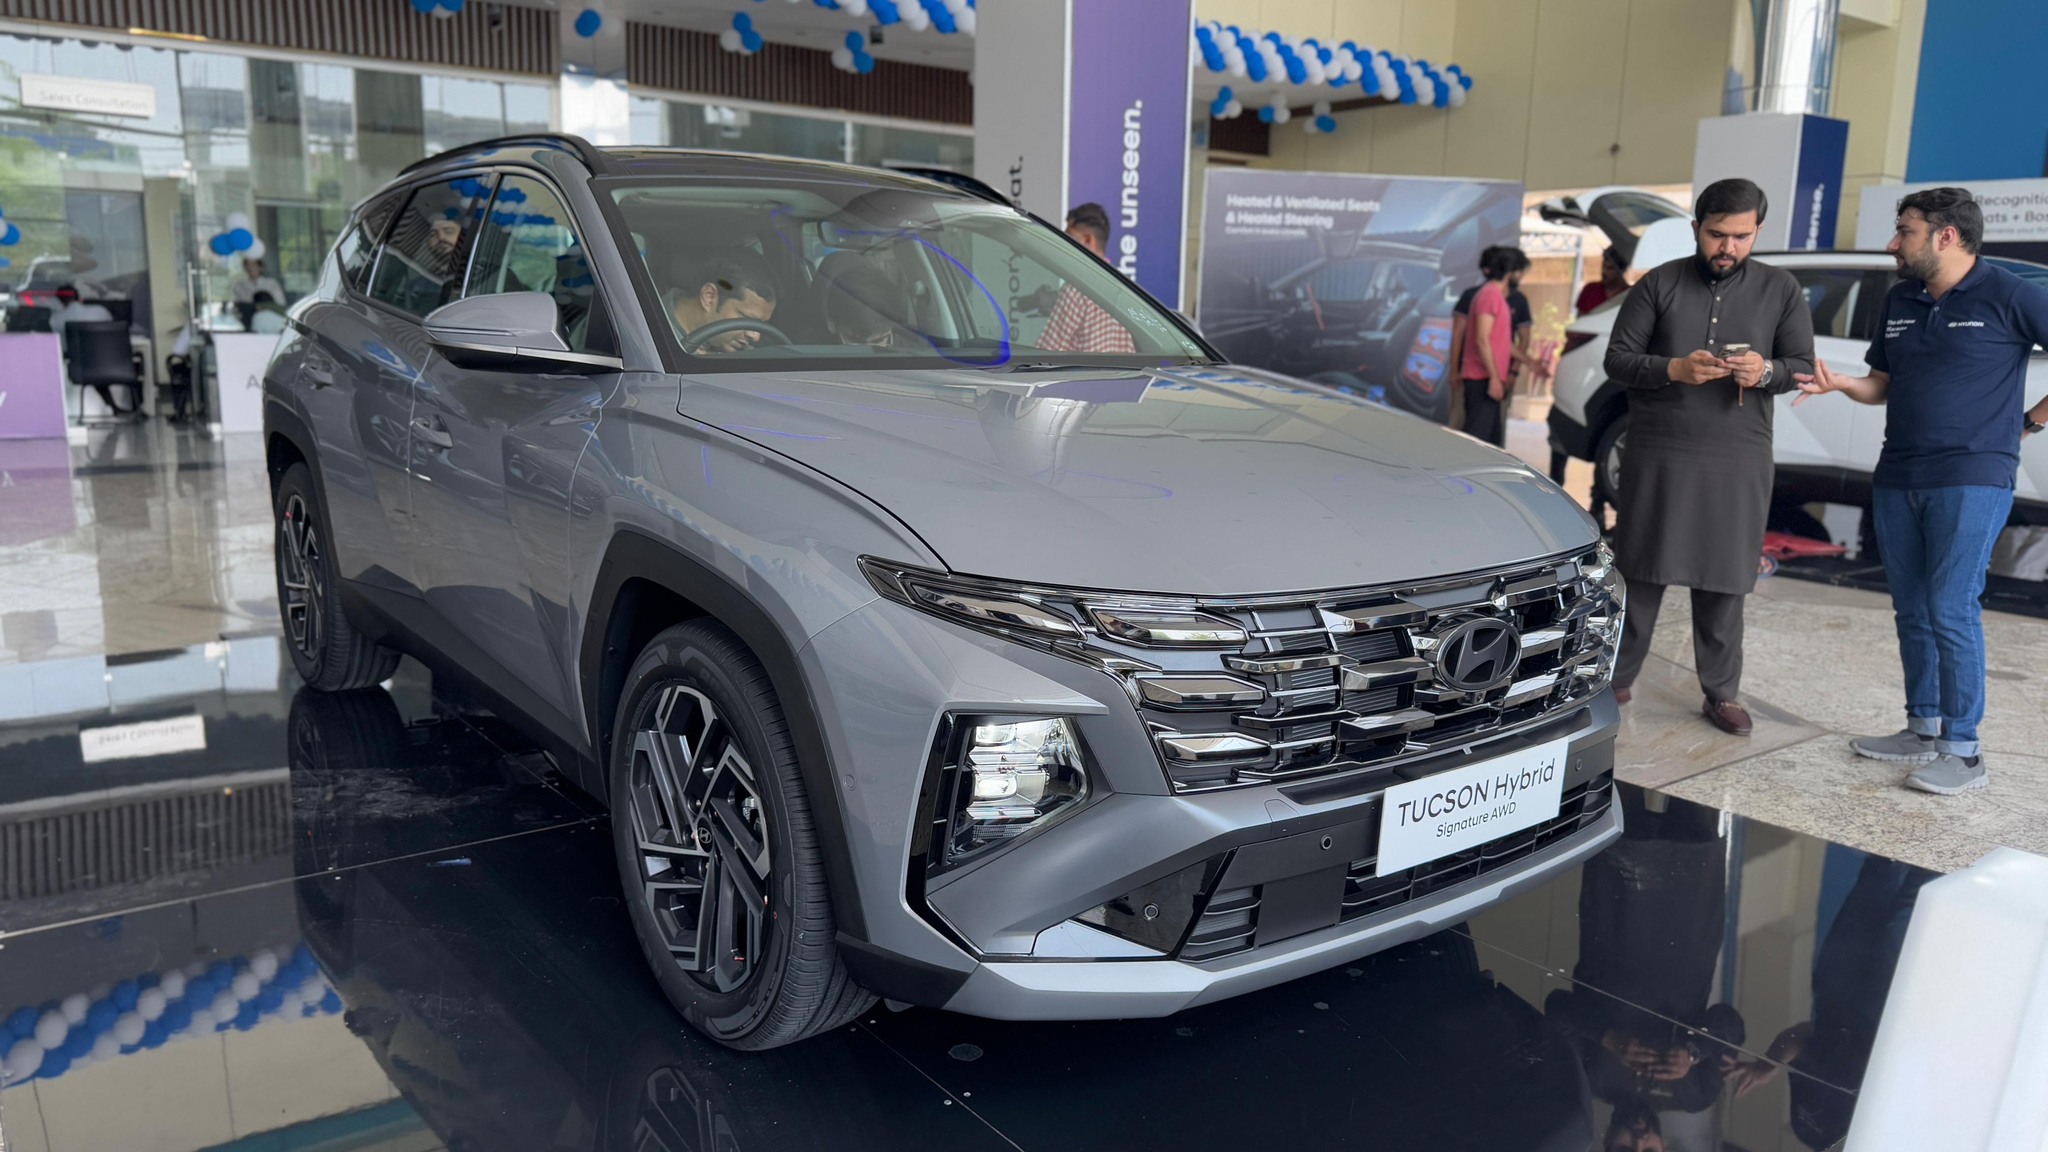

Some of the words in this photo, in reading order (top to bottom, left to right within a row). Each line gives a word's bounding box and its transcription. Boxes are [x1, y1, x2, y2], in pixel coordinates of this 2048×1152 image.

[1120, 99, 1143, 229] unseen.
[1225, 211, 1236, 223] &
[1237, 211, 1283, 225] Heated
[1284, 212, 1334, 230] Steering
[1226, 194, 1273, 208] Heated
[1273, 195, 1283, 208] &
[1285, 196, 1346, 211] Ventilated
[1347, 199, 1381, 212] Seats
[1007, 247, 1024, 343] emory
[1398, 779, 1490, 827] TUCSON
[1493, 757, 1556, 800] Hybrid
[1436, 811, 1489, 838] Signature
[1490, 801, 1517, 821] AWD
